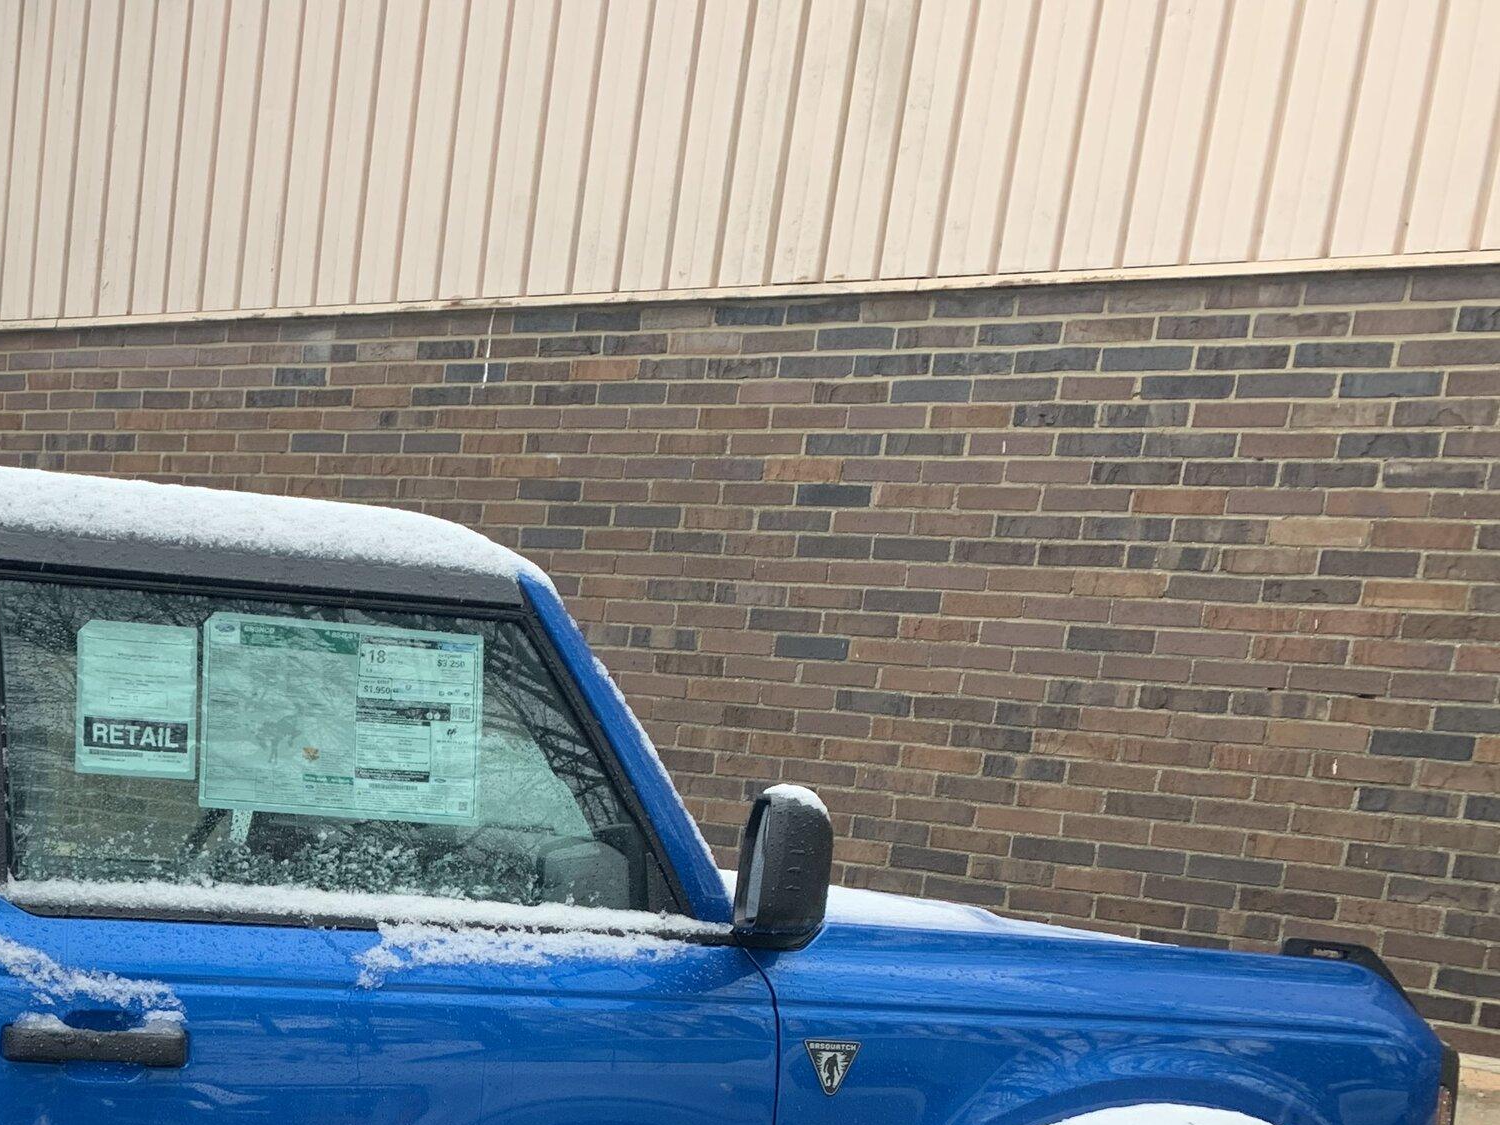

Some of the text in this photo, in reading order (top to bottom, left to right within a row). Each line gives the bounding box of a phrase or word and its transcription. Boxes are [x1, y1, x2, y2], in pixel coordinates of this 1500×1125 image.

[367, 649, 387, 664] 18
[436, 659, 466, 669] $3250
[91, 722, 180, 748] RETAIL
[809, 1042, 857, 1051] SASQUATCH
